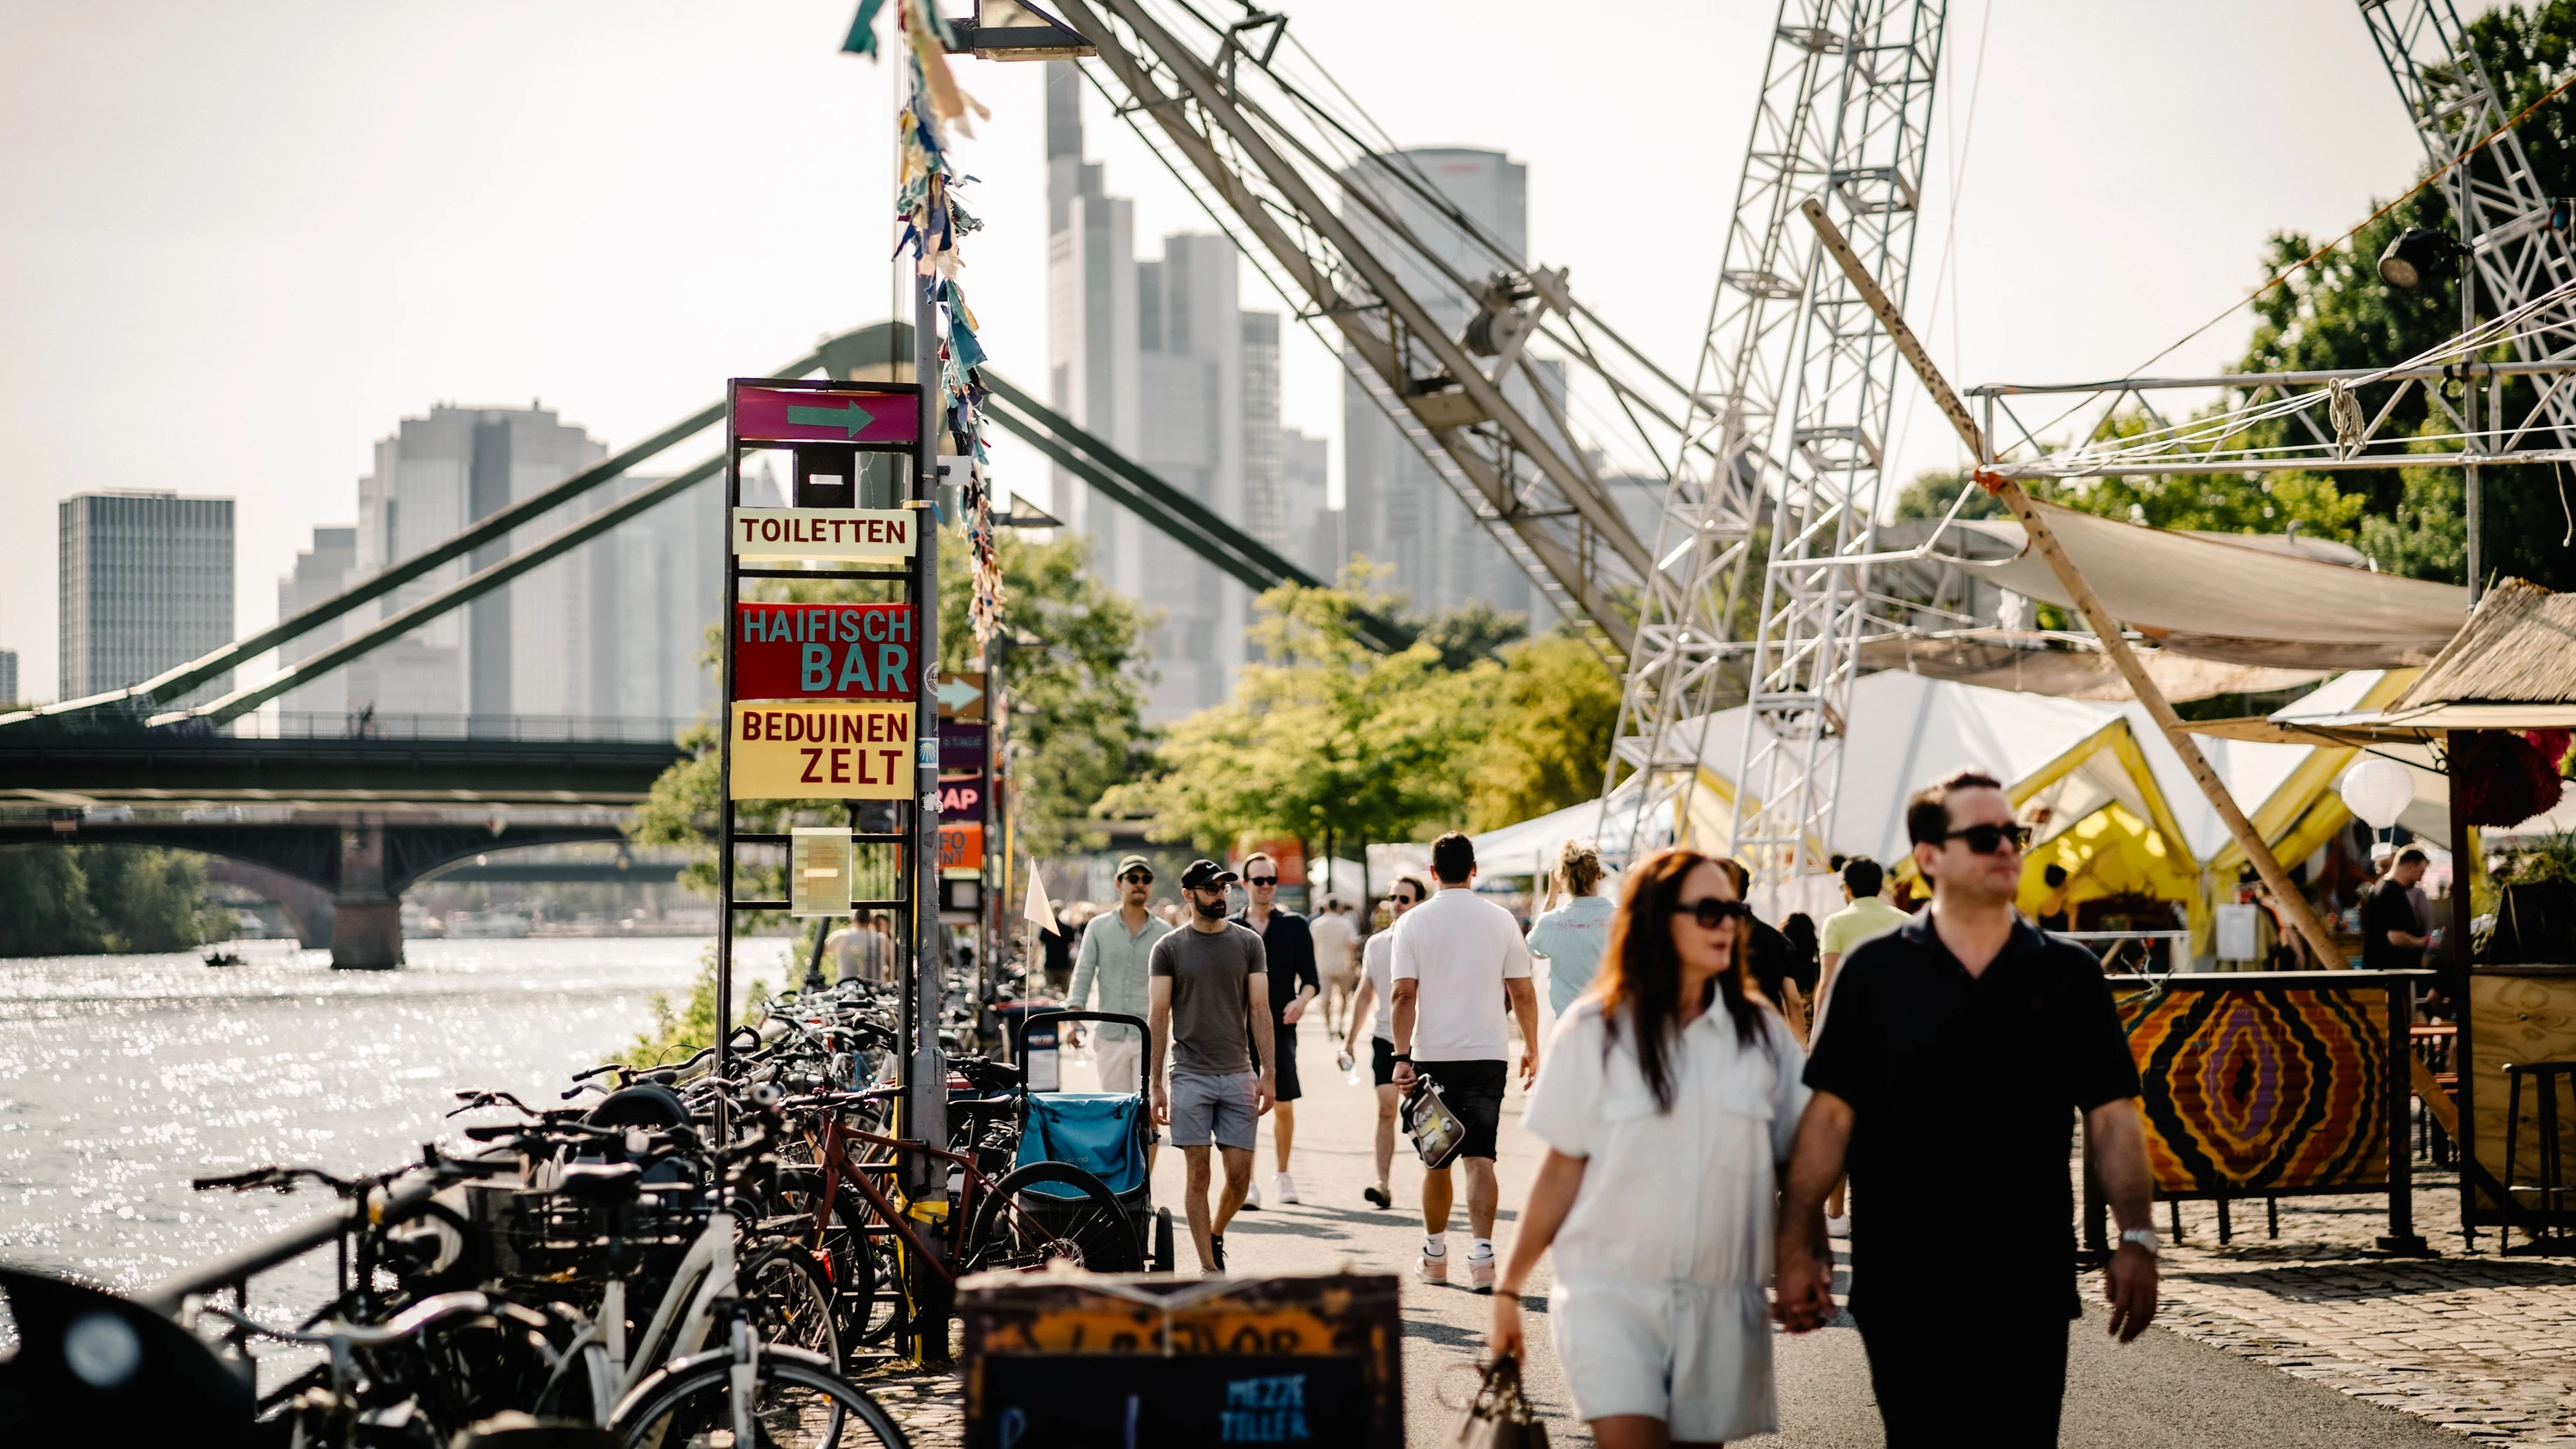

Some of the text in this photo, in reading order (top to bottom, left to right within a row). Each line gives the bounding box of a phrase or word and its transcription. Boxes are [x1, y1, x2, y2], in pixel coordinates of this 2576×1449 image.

[739, 519, 906, 544] TOILETTEN
[744, 610, 910, 642] HAIFISCH
[802, 643, 908, 691] BAR
[743, 712, 907, 743] BEDUINEN
[801, 748, 902, 785] ZELT
[939, 831, 965, 849] FO
